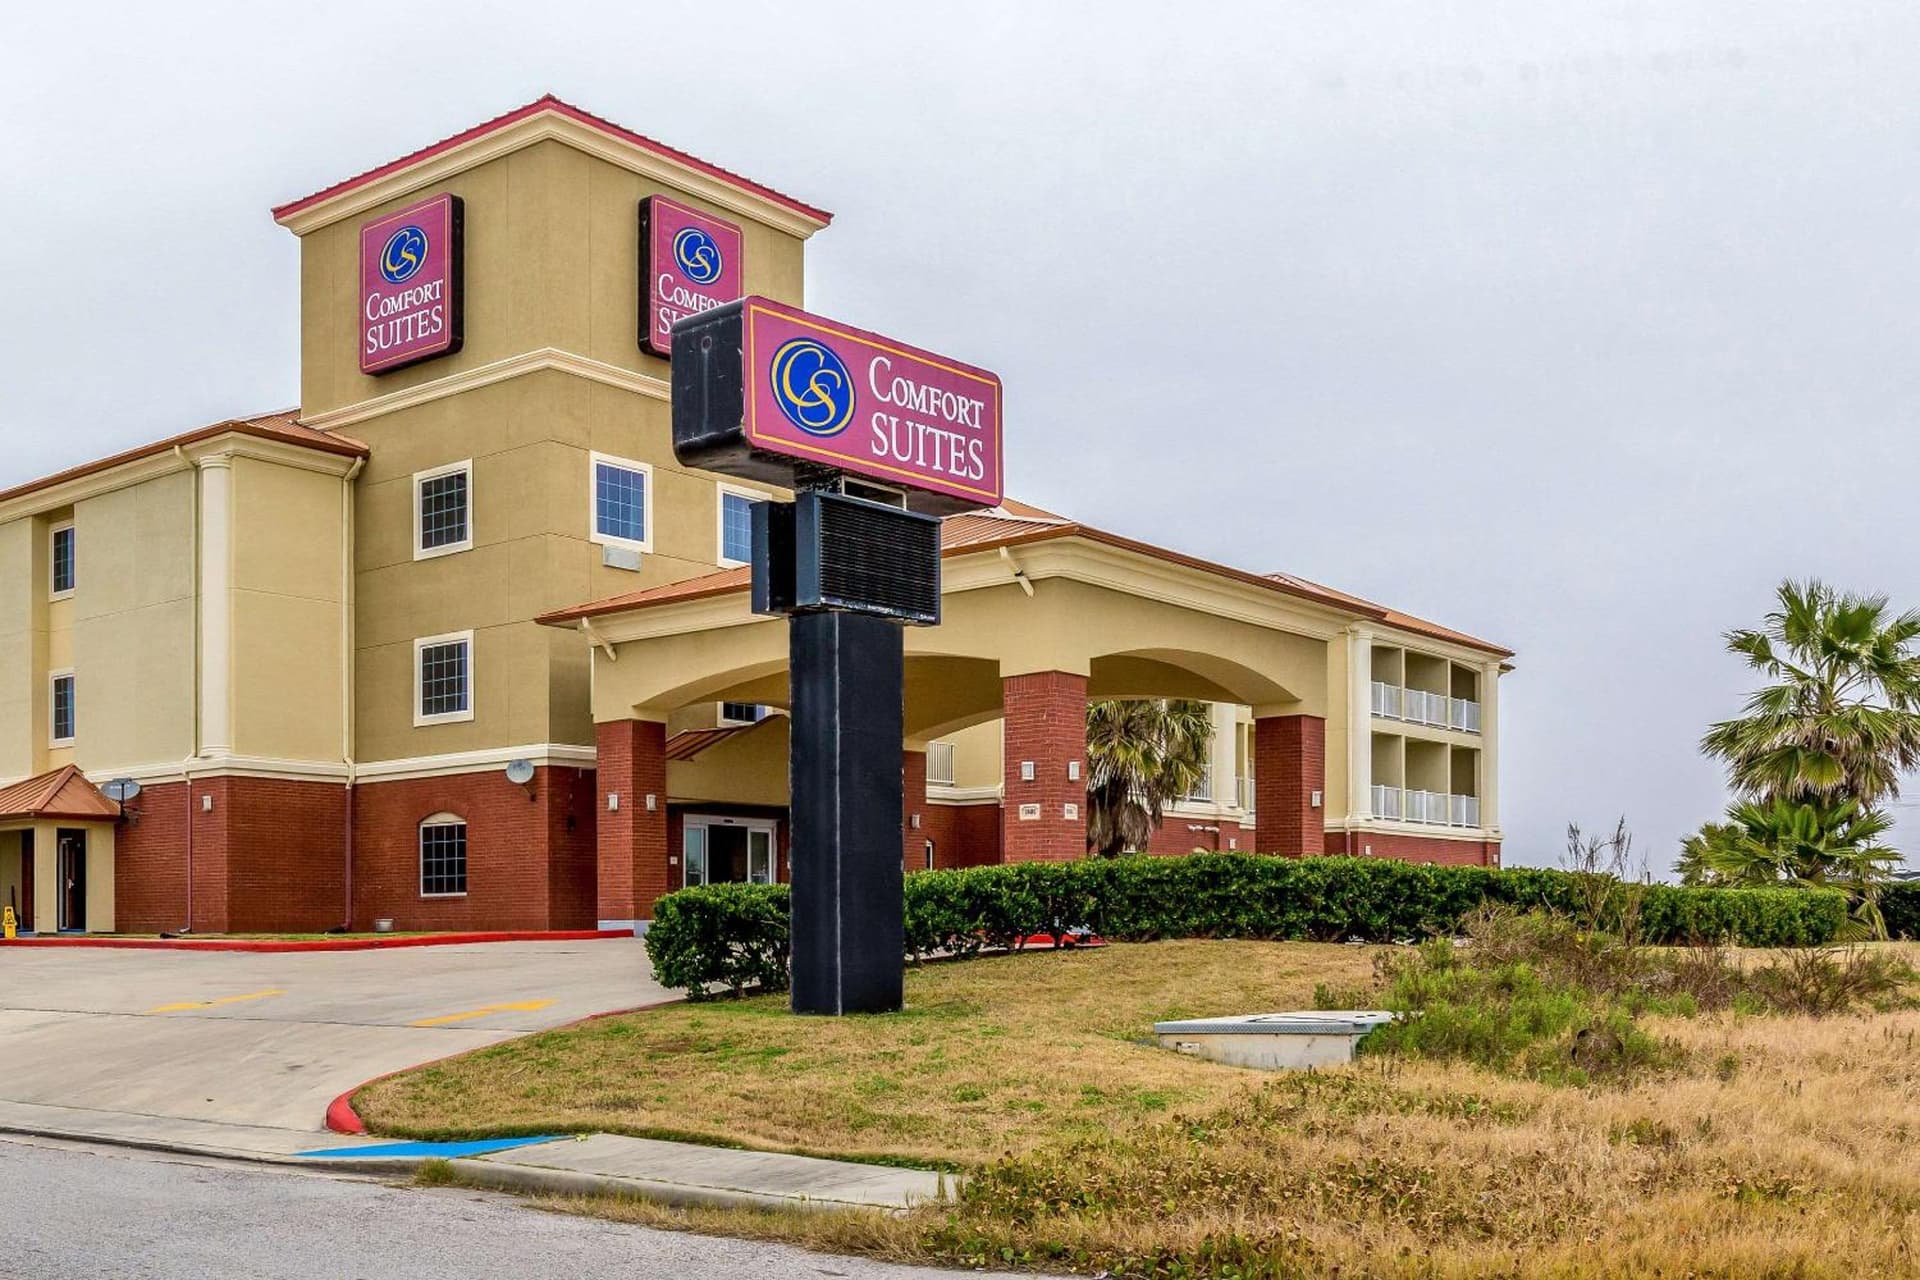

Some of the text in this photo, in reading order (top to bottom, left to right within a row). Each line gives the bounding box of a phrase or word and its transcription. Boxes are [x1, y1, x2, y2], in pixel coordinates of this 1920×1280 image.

[366, 279, 443, 321] COMFORT
[658, 273, 723, 313] COMFO
[367, 305, 442, 354] SUITES
[868, 356, 984, 429] COMFORT
[871, 412, 984, 481] SUITES
